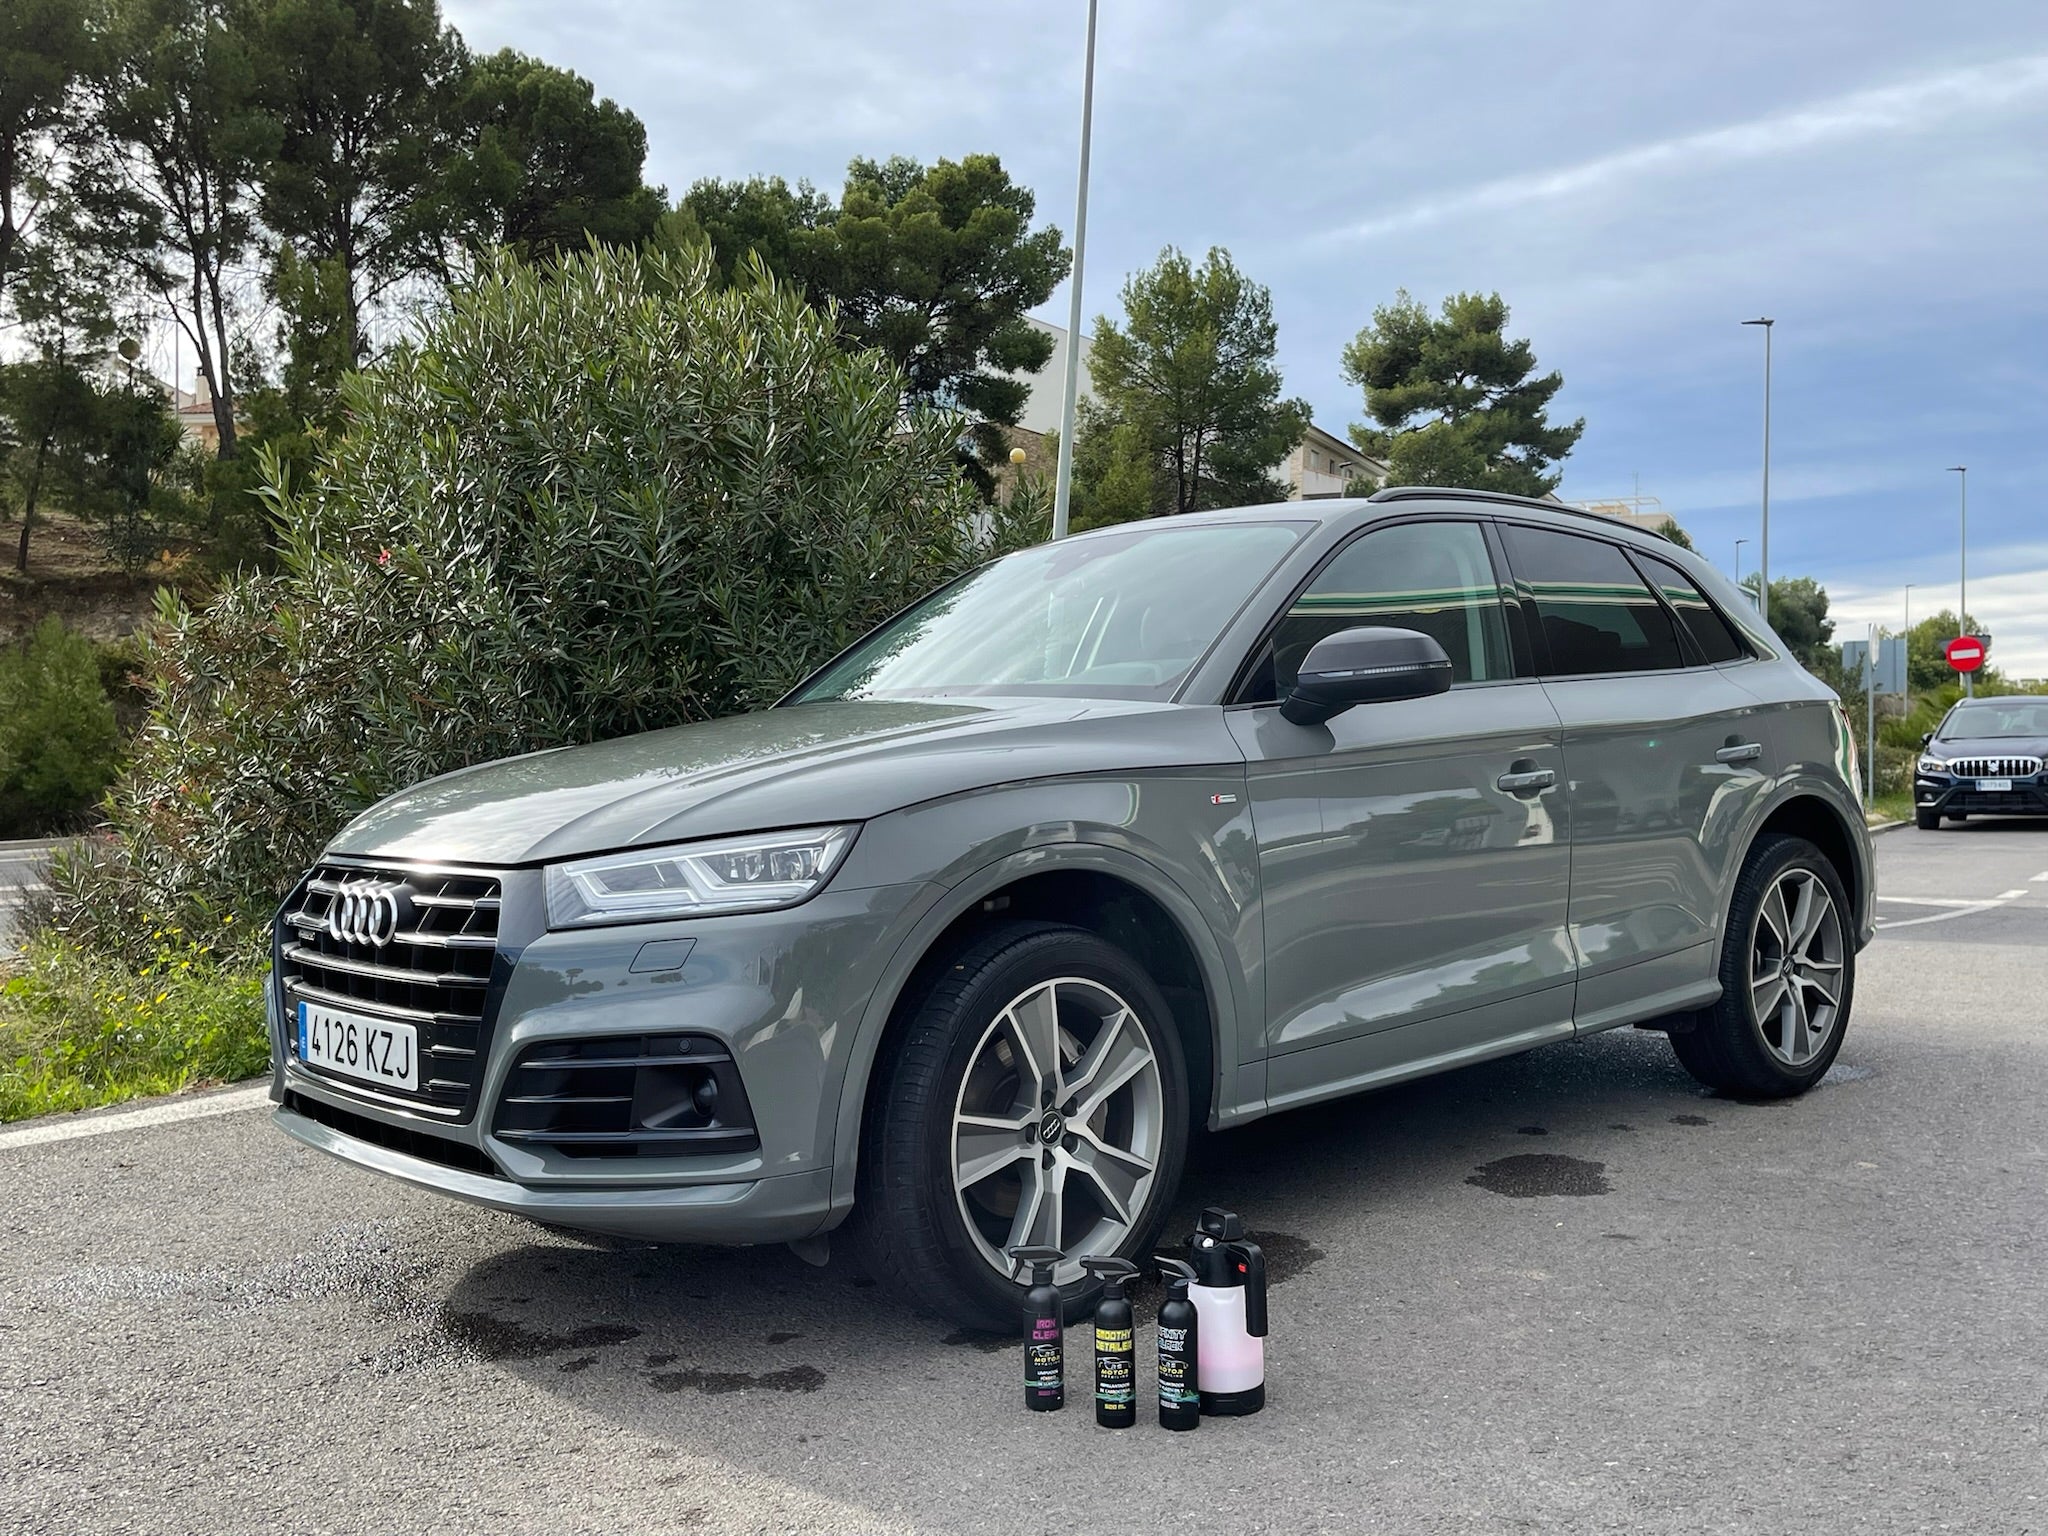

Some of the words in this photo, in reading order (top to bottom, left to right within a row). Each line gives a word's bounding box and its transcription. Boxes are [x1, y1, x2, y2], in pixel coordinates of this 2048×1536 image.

[312, 1015, 358, 1066] 4126
[366, 1027, 410, 1079] KZJ
[1036, 1318, 1056, 1330] IRON
[1095, 1327, 1133, 1341] SMOOTHY
[1100, 1368, 1129, 1376] MOTOR
